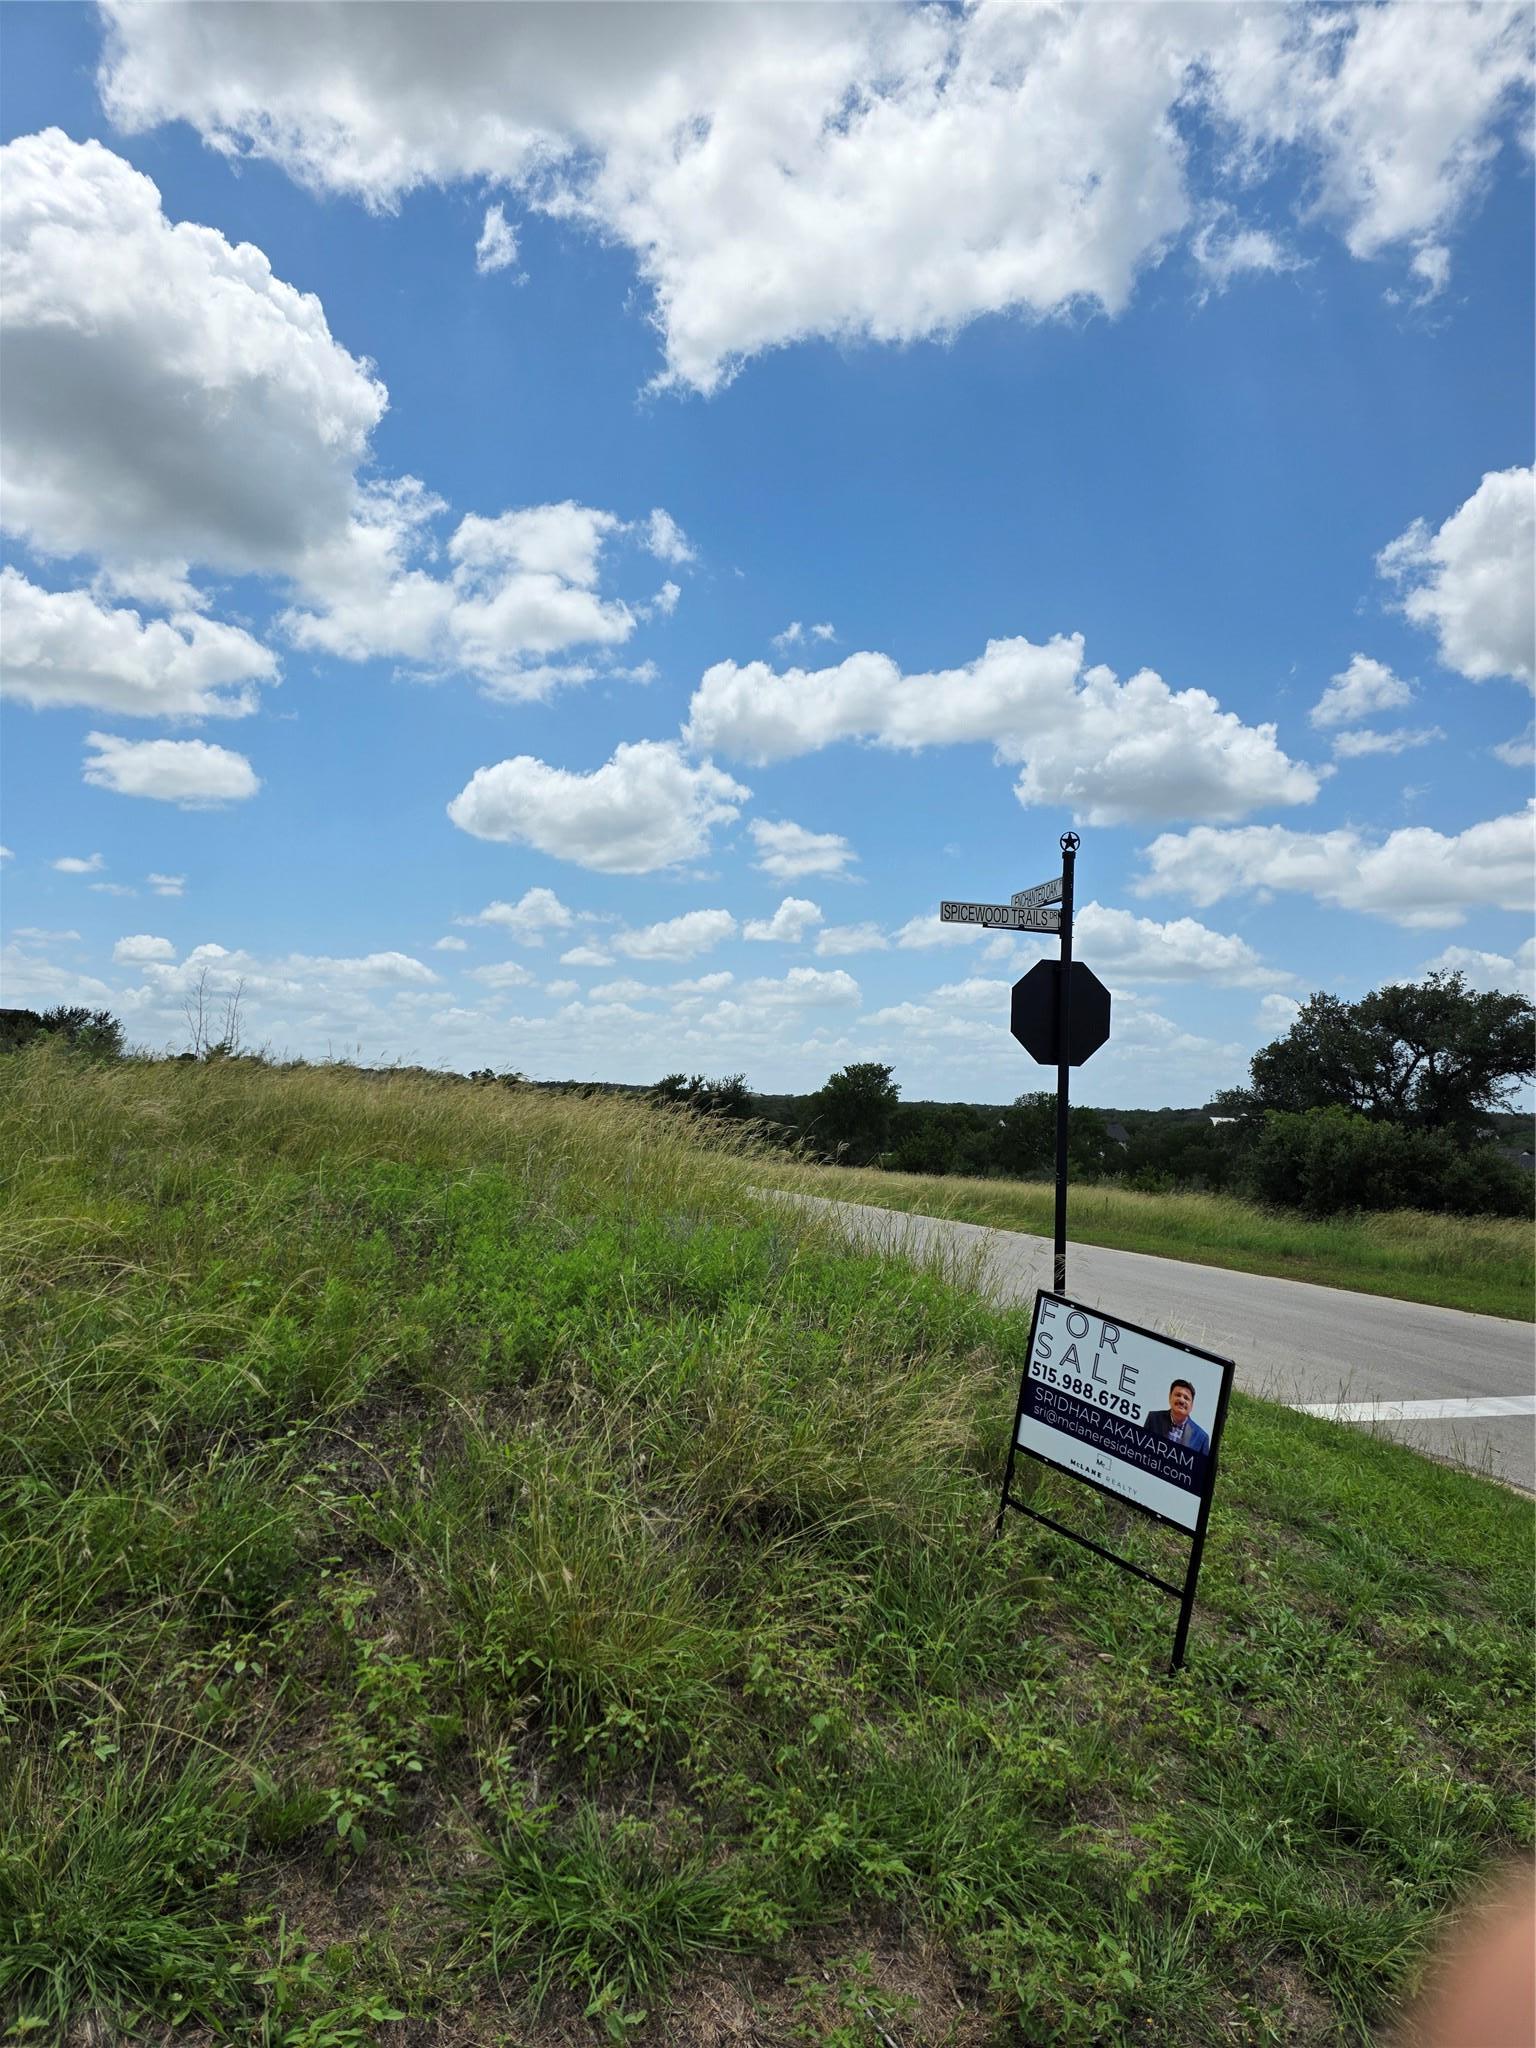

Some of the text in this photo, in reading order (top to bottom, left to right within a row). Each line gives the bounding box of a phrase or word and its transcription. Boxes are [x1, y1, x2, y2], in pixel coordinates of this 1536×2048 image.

[944, 904, 1058, 926] SPICEWOOD TRAILS DR
[1039, 1299, 1121, 1355] FOR
[1031, 1360, 1142, 1421] 515.988.6785
[1035, 1331, 1140, 1397] SALE
[1033, 1404, 1193, 1487] sri@mclaneresidential.com
[1034, 1386, 1195, 1471] SRIDHAR AKAVARAM
[1105, 1475, 1138, 1496] REALTY
